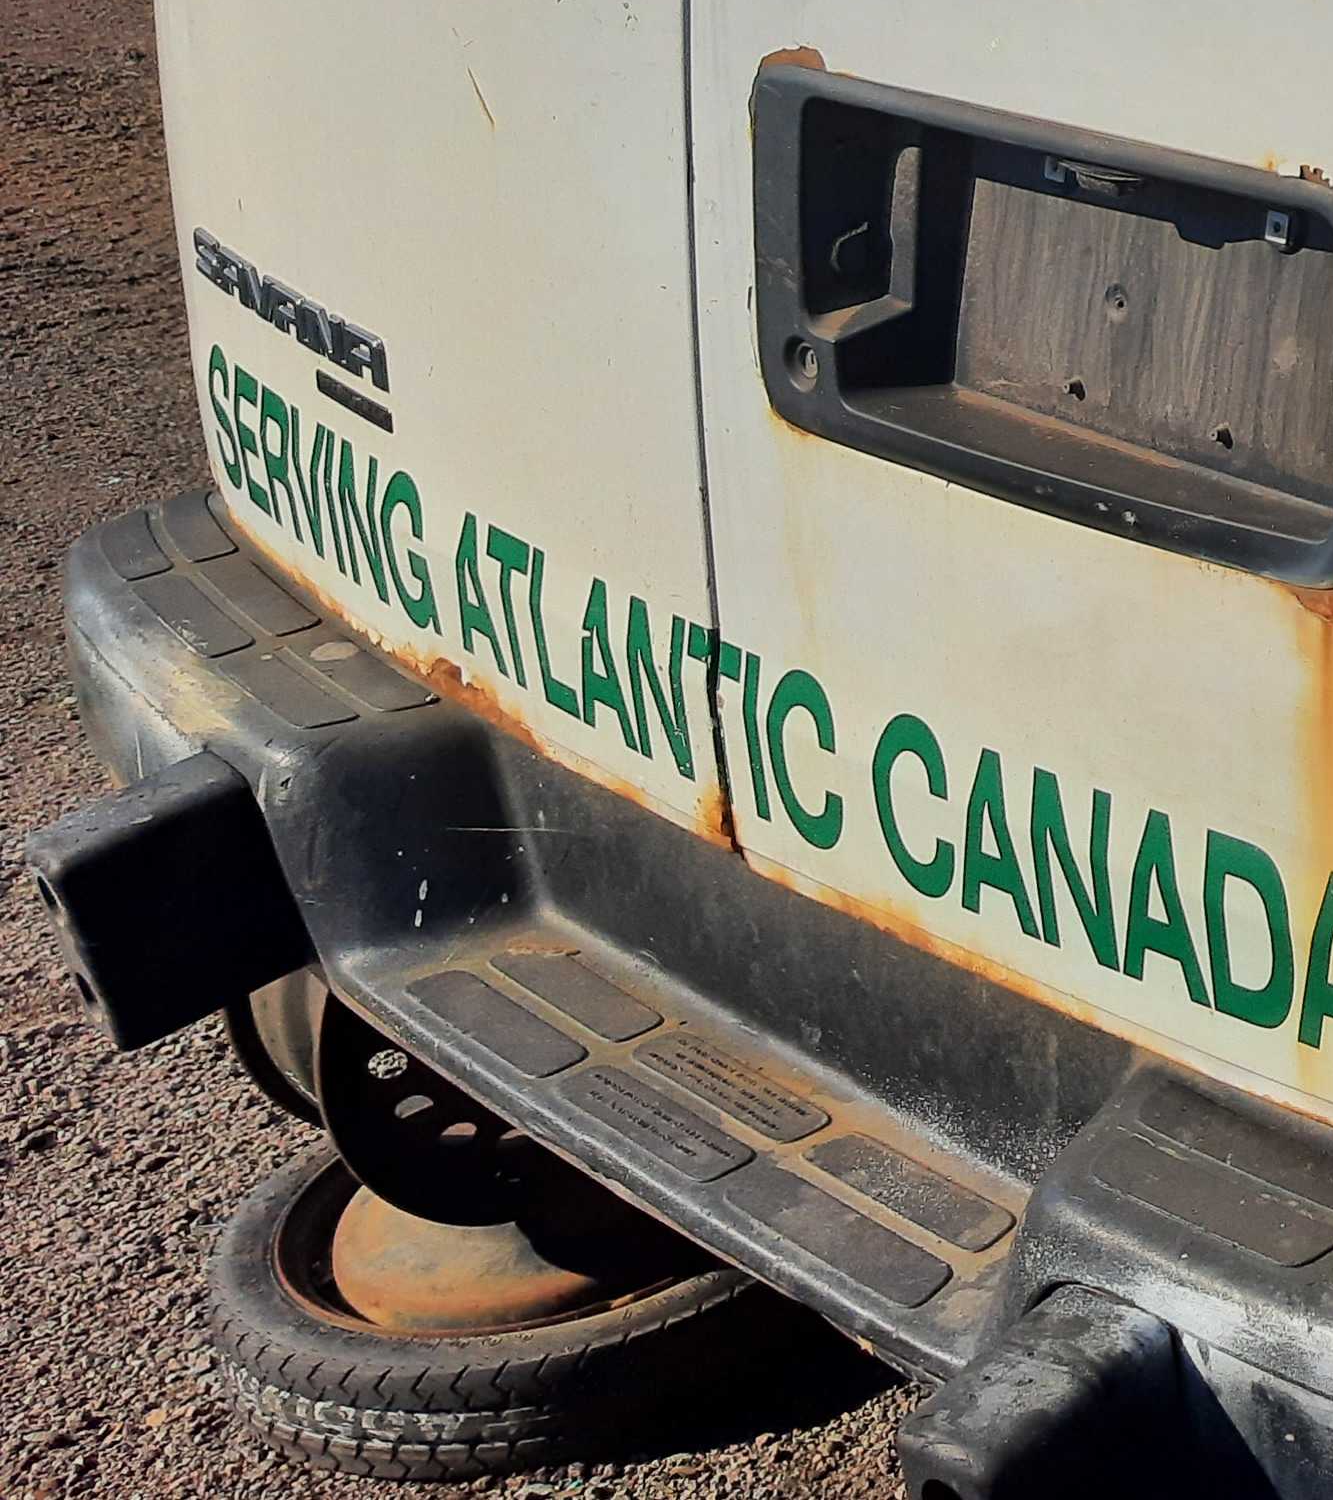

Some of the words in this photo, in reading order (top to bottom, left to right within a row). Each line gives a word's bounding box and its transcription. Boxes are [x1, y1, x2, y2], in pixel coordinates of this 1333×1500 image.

[194, 227, 389, 393] SAVANA
[208, 344, 442, 636] SERVING
[455, 512, 843, 849] ATLANTIC
